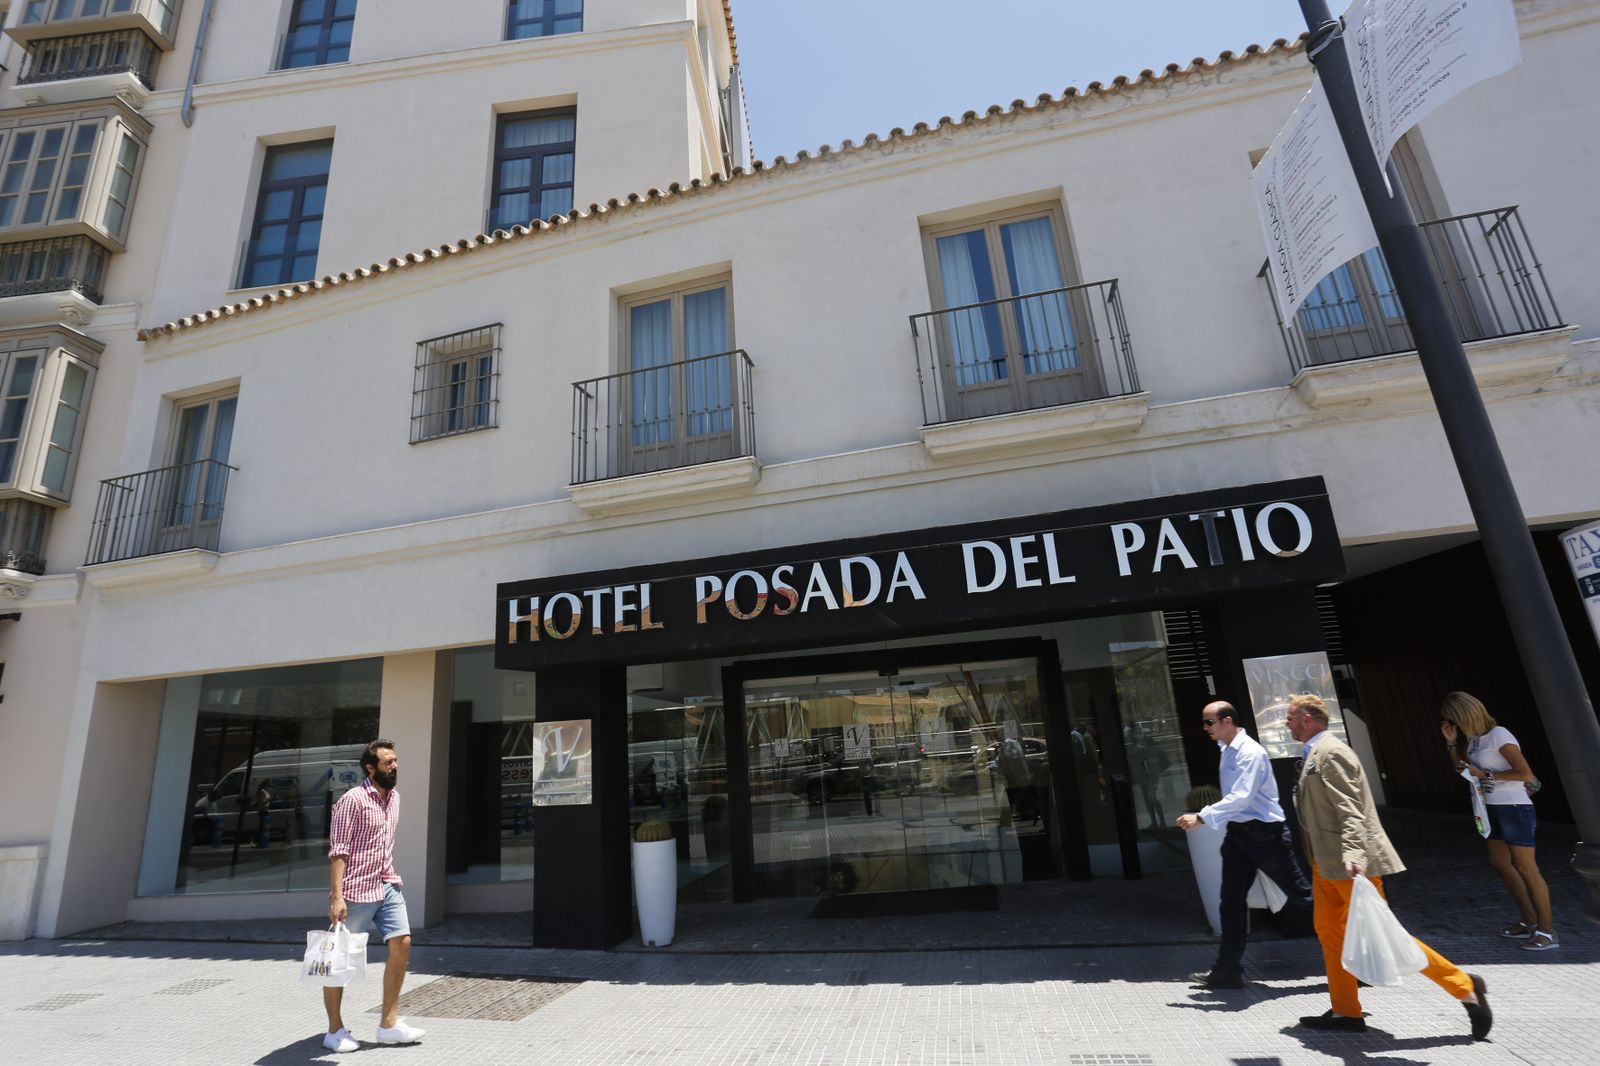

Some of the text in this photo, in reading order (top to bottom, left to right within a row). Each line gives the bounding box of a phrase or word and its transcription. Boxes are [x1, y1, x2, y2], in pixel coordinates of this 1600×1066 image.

[508, 502, 1313, 645] HOTEL POSADA DEL PATIO
[1250, 663, 1329, 684] VINCCI
